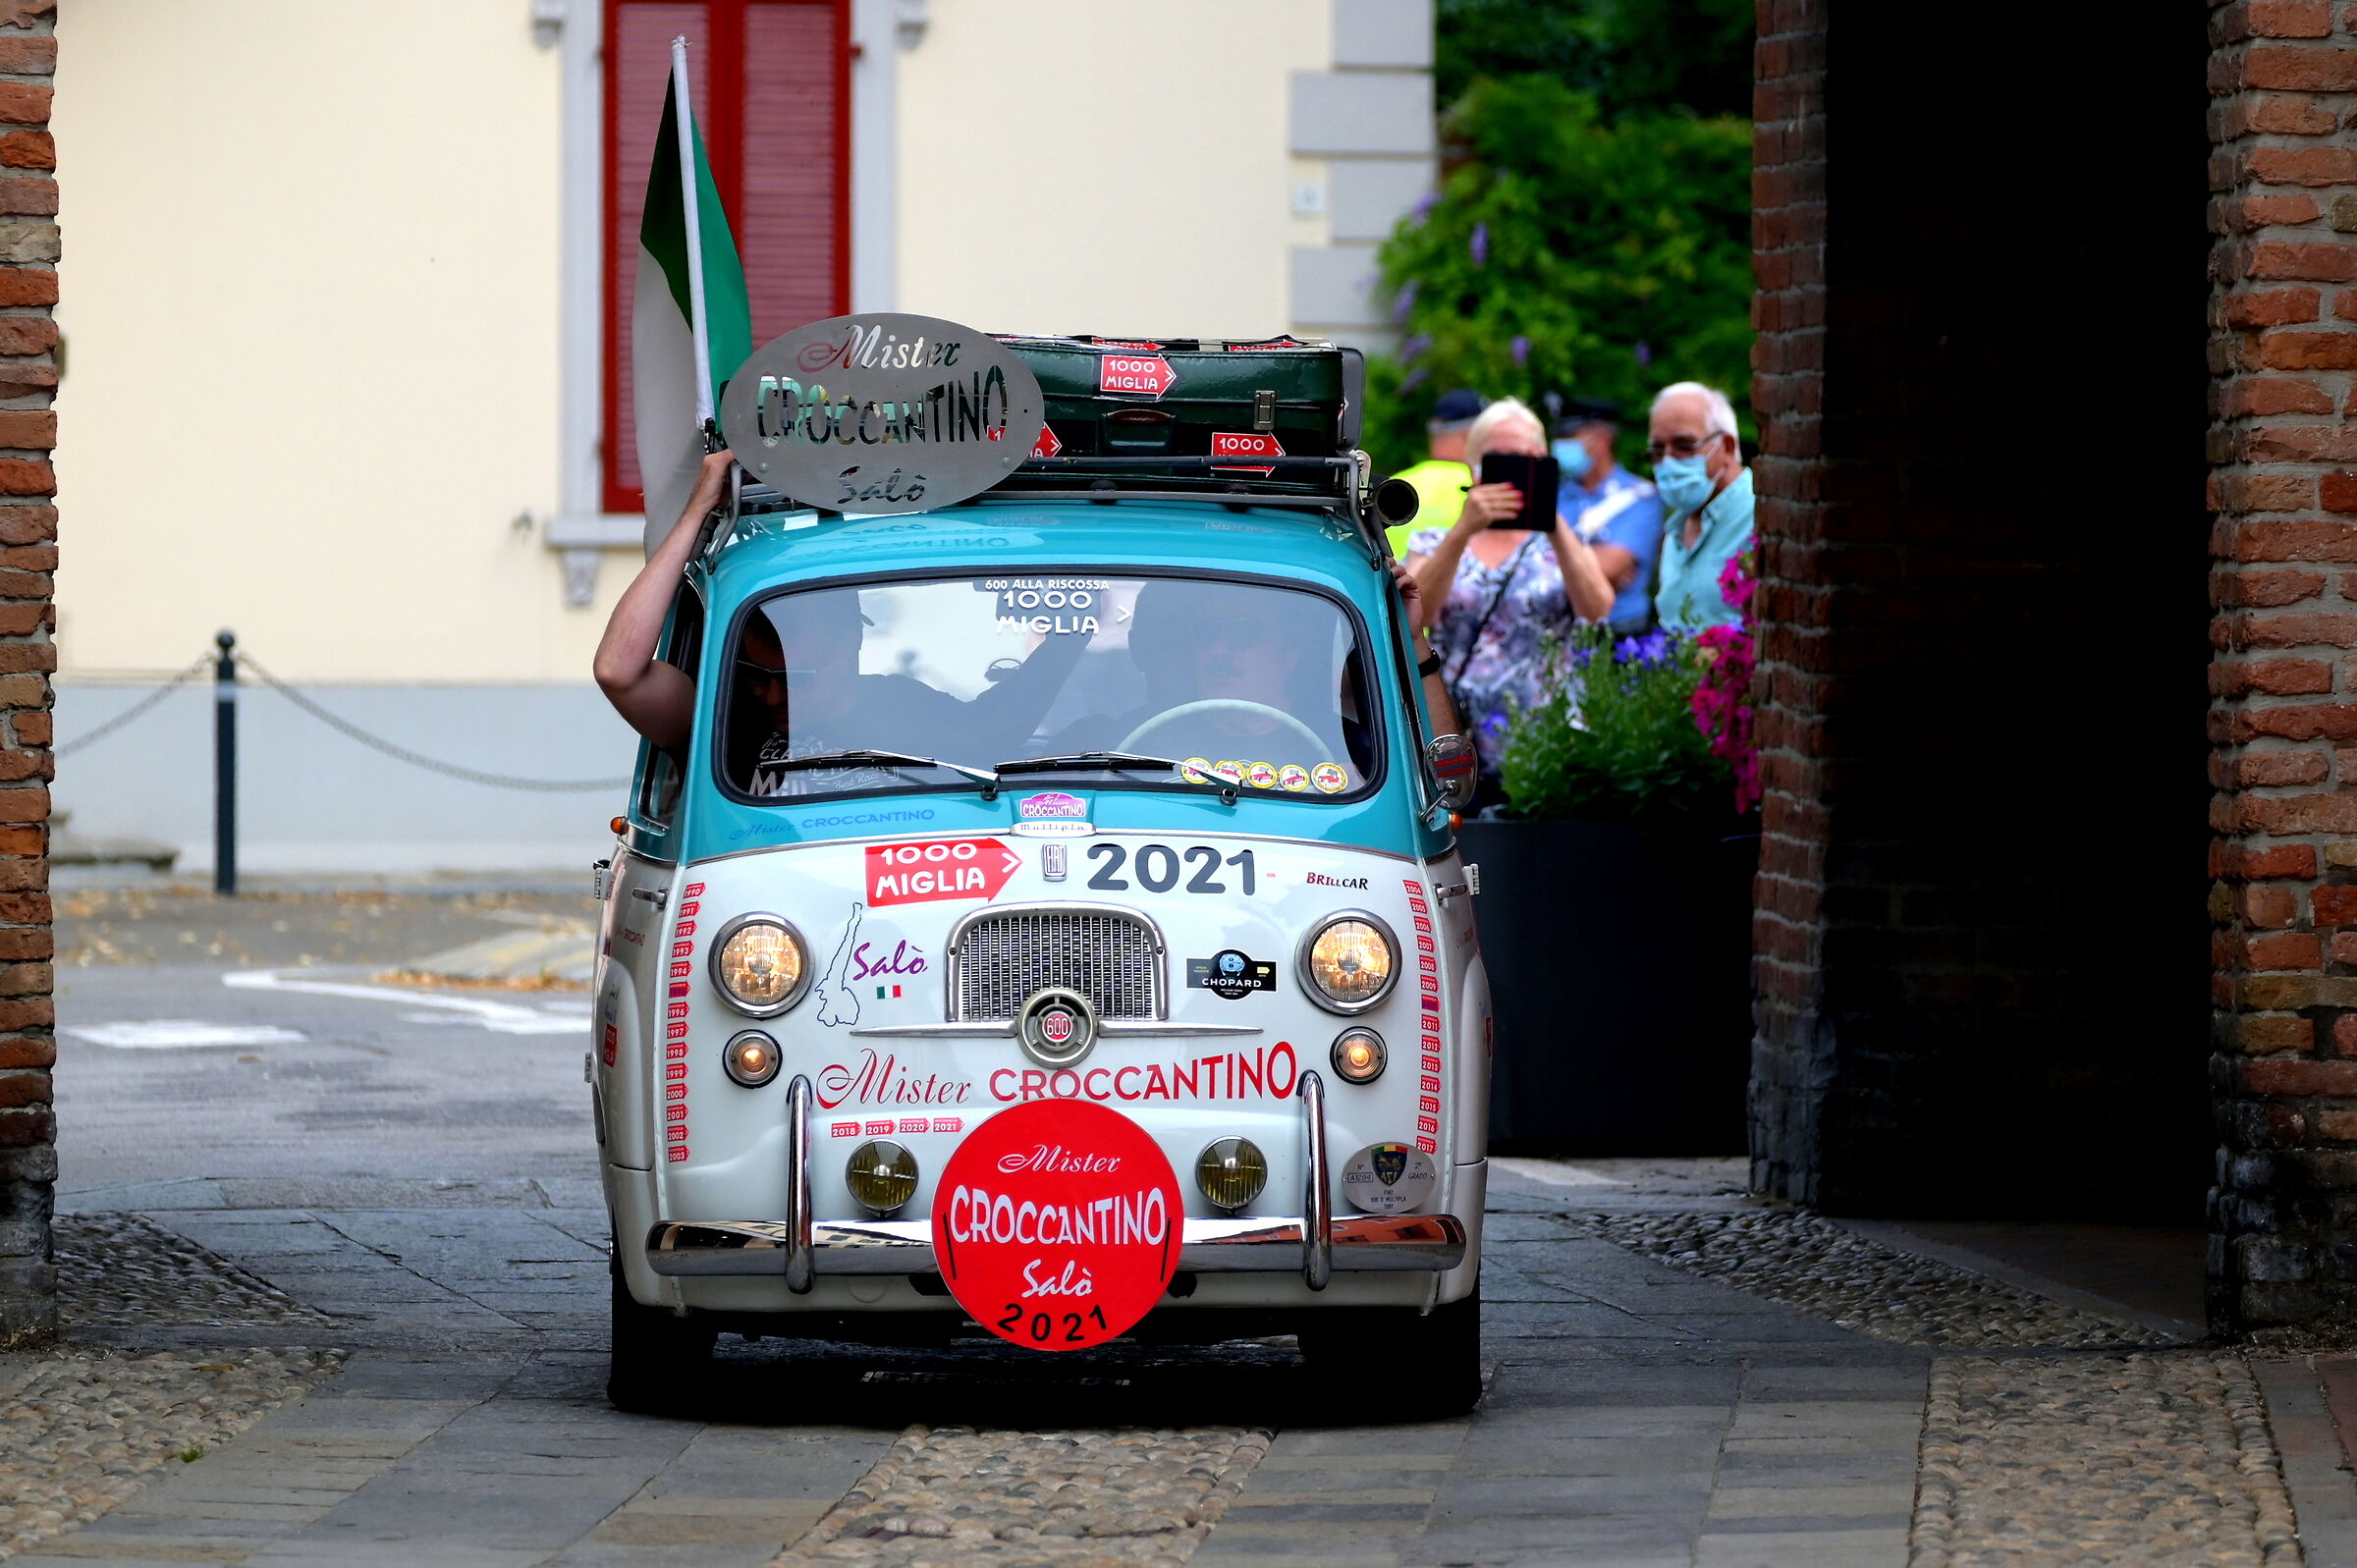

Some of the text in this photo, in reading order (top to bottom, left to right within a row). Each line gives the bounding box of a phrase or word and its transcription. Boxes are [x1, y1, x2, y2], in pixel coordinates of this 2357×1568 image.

[797, 324, 960, 373] Mister
[1109, 359, 1156, 373] 1000
[1105, 375, 1158, 391] MIGLIA
[756, 364, 1008, 447] CROCCANTINO
[1220, 437, 1265, 452] 1000
[837, 465, 927, 504] Salò
[985, 578, 1110, 590] 600 ALLA RISCOSSA
[1003, 590, 1093, 609] 1000
[996, 615, 1100, 634] MIGLIA
[1022, 803, 1084, 817] CROCCANTINO
[801, 809, 935, 830] CROCCANTINO
[880, 842, 977, 866] 1000
[1087, 842, 1256, 896] 2021
[875, 866, 986, 898] MIGLIA
[685, 887, 700, 896] 1990
[1405, 885, 1422, 894] 2004
[680, 907, 694, 916] 1991
[1411, 902, 1427, 913] 2005
[676, 926, 691, 936] 1992
[1415, 921, 1431, 932] 2006
[673, 946, 689, 956] 1993
[1418, 941, 1433, 950] 2007
[851, 939, 928, 981] Salò
[671, 965, 687, 975] 1994
[1201, 978, 1262, 988] CHOPARD
[1421, 980, 1437, 991] 2009
[668, 1007, 685, 1017] 1996
[1046, 1017, 1069, 1036] 600
[1422, 1021, 1438, 1031] 2011
[668, 1028, 684, 1038] 1997
[1422, 1041, 1439, 1052] 2012
[667, 1048, 684, 1057] 1998
[1422, 1060, 1439, 1071] 2013
[667, 1068, 684, 1079] 1999
[816, 1041, 1297, 1109] Mister CROCCANTINO
[1421, 1081, 1438, 1092] 2014
[667, 1089, 684, 1100] 2000
[1420, 1102, 1437, 1111] 2015
[668, 1109, 684, 1120] 2001
[832, 1127, 855, 1137] 2018
[866, 1125, 890, 1134] 2019
[901, 1123, 925, 1132] 2020
[934, 1122, 957, 1131] 2021
[1418, 1121, 1435, 1132] 2016
[668, 1131, 685, 1141] 2002
[1417, 1141, 1434, 1153] 2017
[669, 1152, 685, 1162] 2003
[997, 1144, 1122, 1173] Mister
[950, 1184, 1167, 1246] CROCCANTINO
[1020, 1259, 1093, 1298] Salò
[997, 1303, 1108, 1342] 2021
